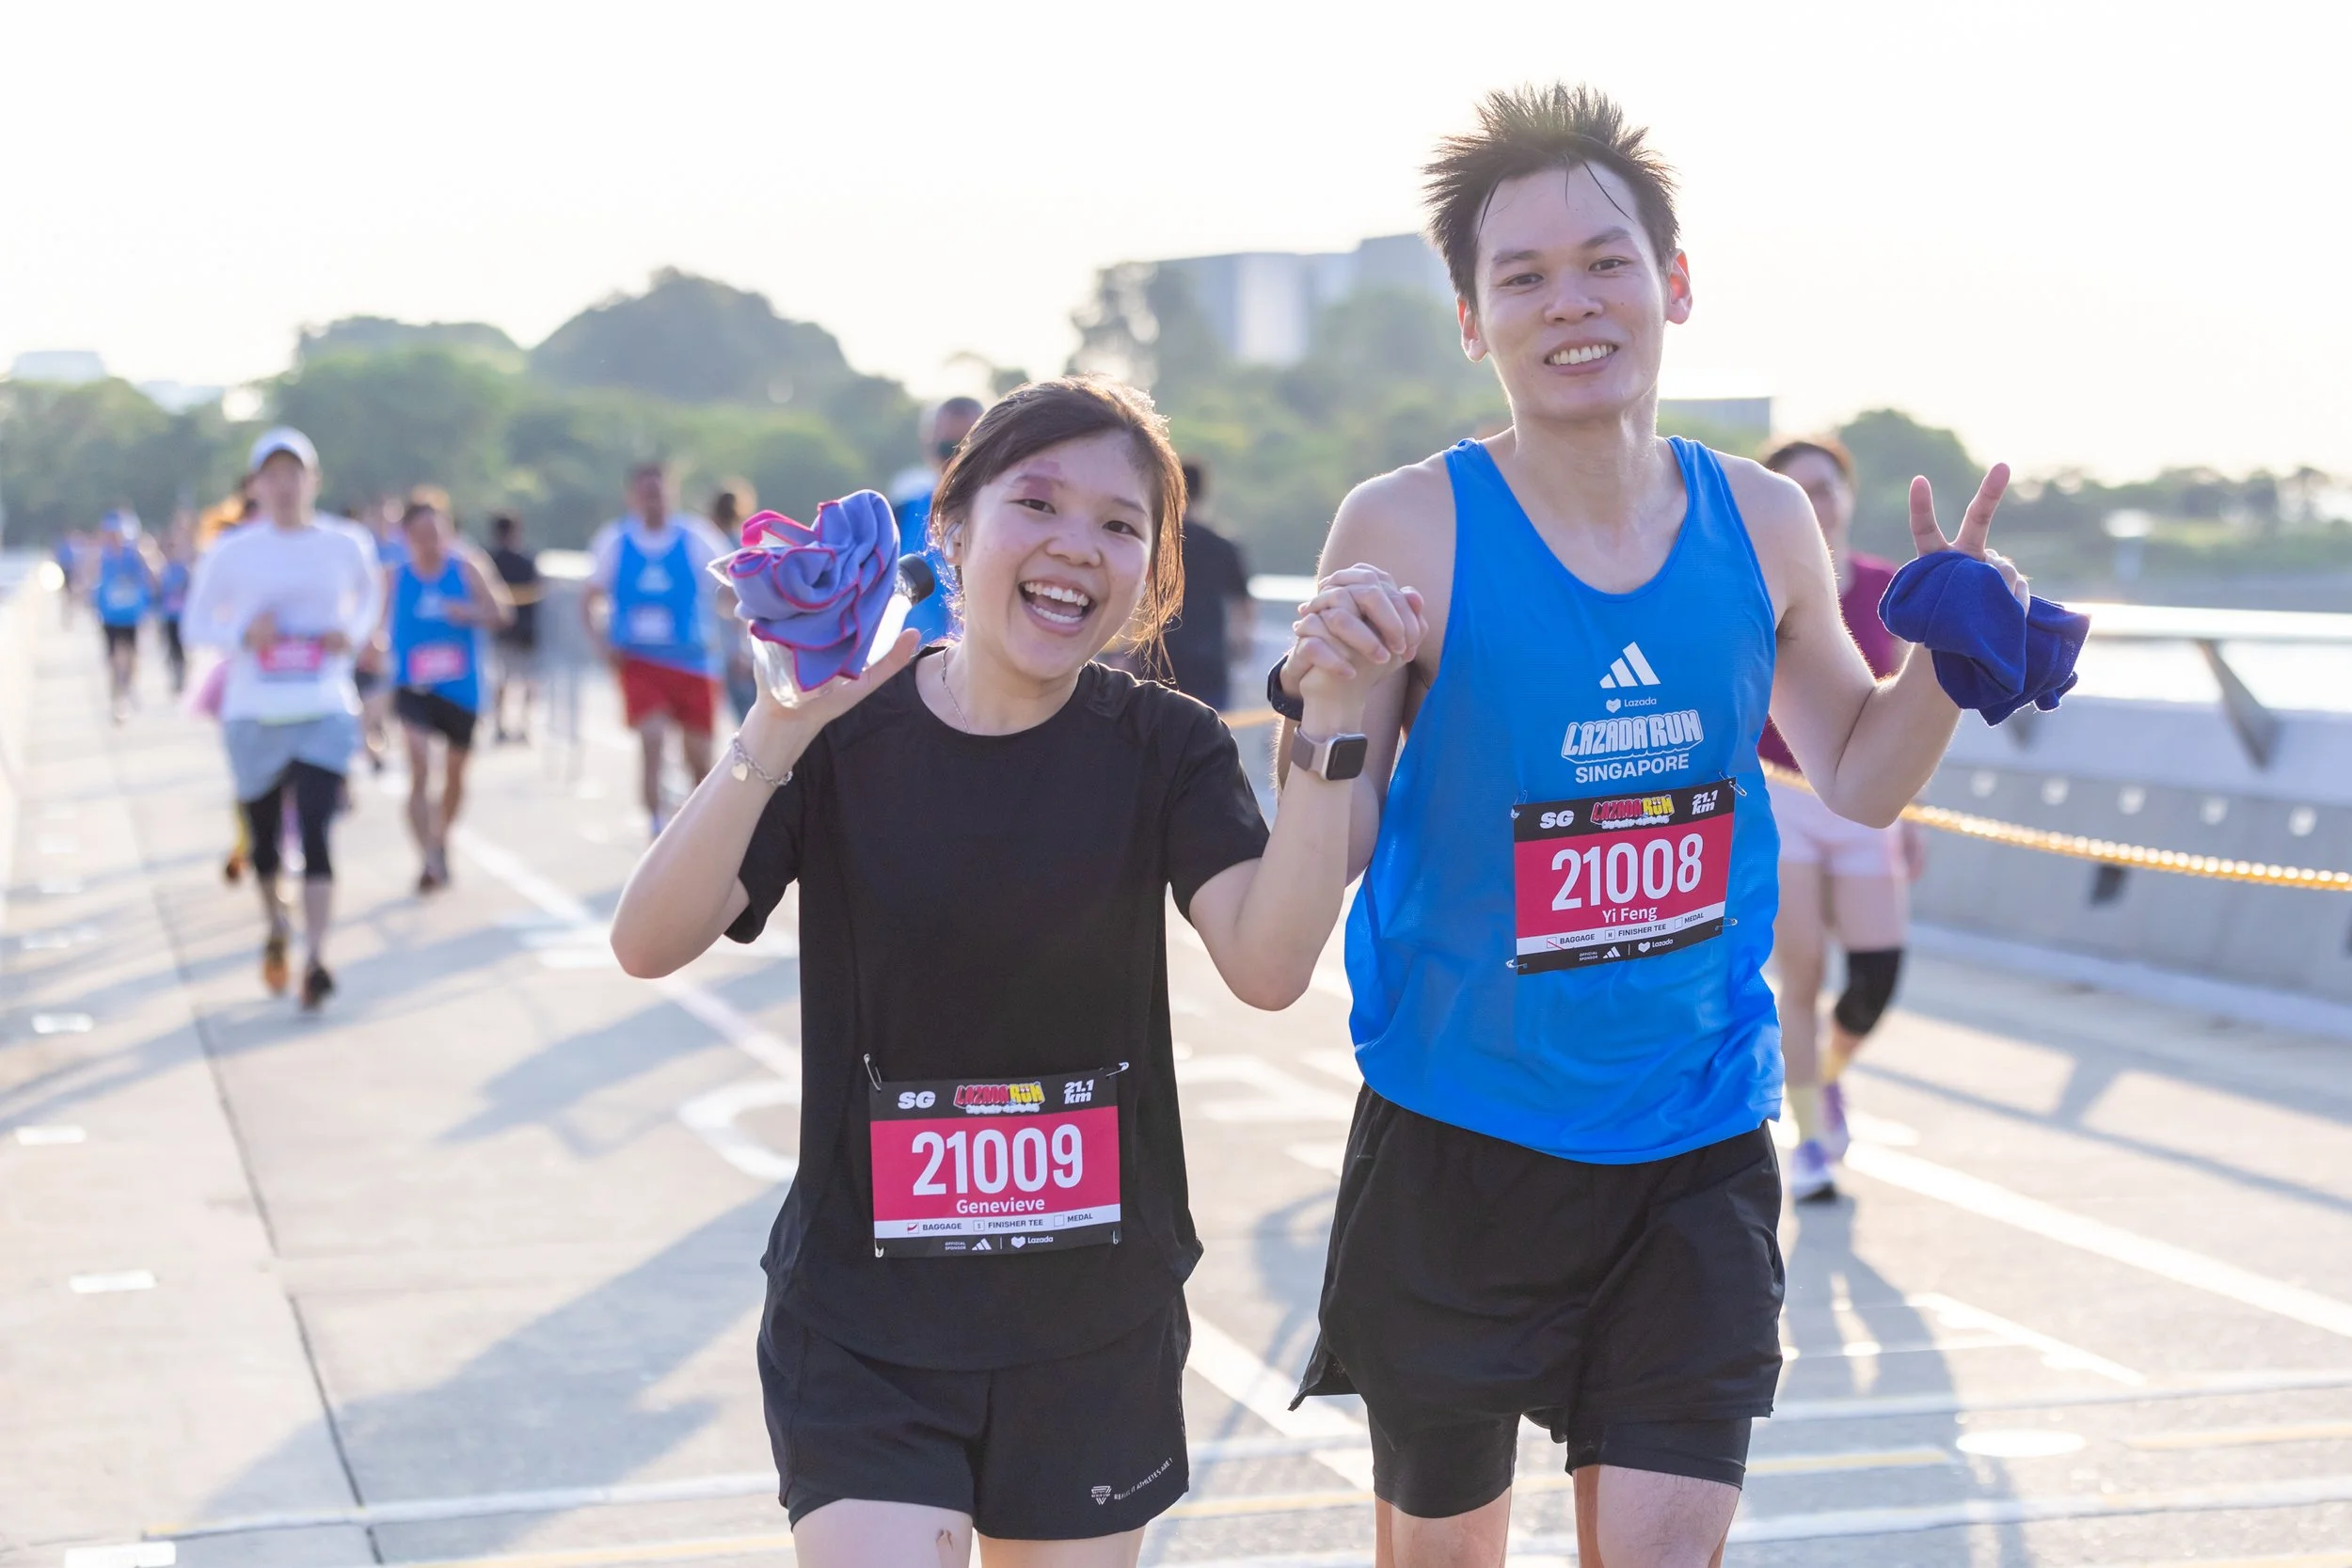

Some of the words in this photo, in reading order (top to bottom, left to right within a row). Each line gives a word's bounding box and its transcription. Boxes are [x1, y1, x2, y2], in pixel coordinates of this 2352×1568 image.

[1624, 696, 1657, 707] Lazada
[1562, 717, 1648, 757] LAZADA
[1648, 710, 1703, 748] RUN
[1575, 752, 1690, 784] SINGAPORE
[1692, 789, 1719, 804] 21.1
[1692, 800, 1715, 816] km
[1539, 810, 1575, 830] SG
[1550, 832, 1704, 911] 21008
[1602, 909, 1616, 924] Yi
[1621, 907, 1658, 922] Feng
[1684, 912, 1704, 924] MEDAL
[1560, 934, 1595, 944] BAGGAGE
[1618, 927, 1652, 937] FINISHER
[1651, 938, 1674, 948] Lazada
[1064, 1079, 1094, 1094] 21.1
[898, 1091, 936, 1109] SG
[1064, 1091, 1091, 1104] km
[911, 1123, 1083, 1196] 21009
[956, 1196, 1045, 1214] Genevieve
[988, 1220, 1025, 1228] FINISHER
[1067, 1213, 1093, 1223] MEDAL
[922, 1223, 962, 1231] BAGGAGE
[1027, 1235, 1054, 1244] Lazada
